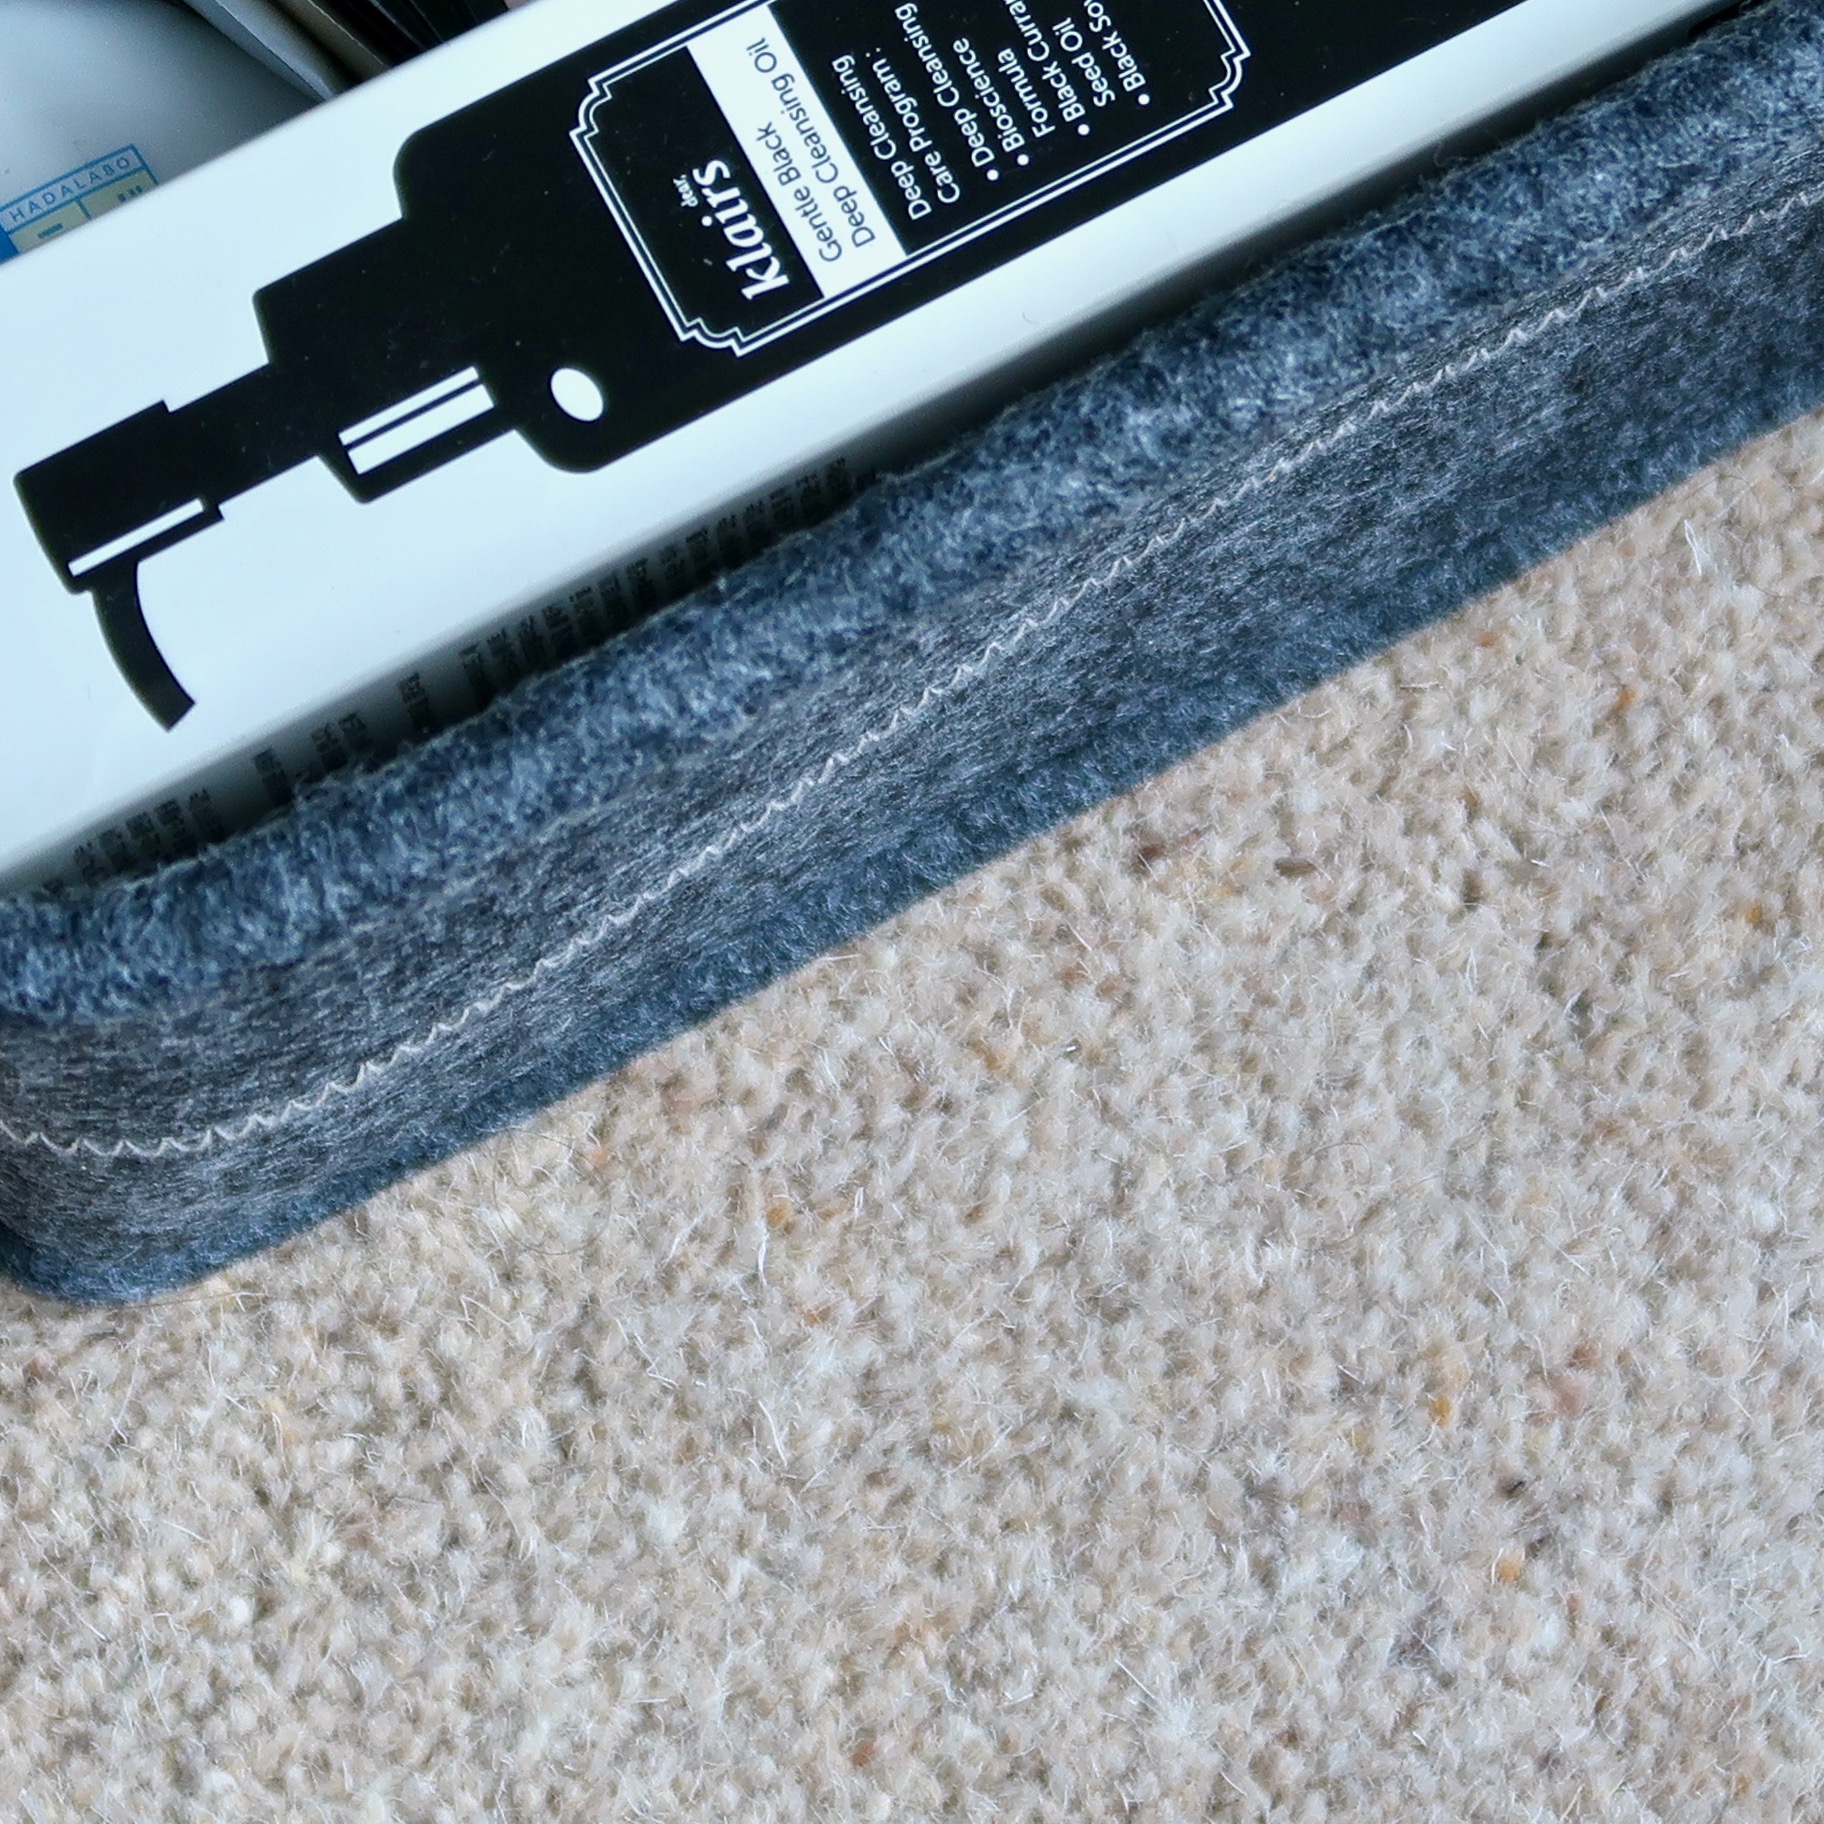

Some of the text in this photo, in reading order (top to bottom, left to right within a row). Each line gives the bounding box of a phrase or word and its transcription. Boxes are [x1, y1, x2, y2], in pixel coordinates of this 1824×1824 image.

[872, 58, 932, 151] Program
[894, 3, 994, 166] Deep Cleansing
[952, 37, 1024, 152] Bioscience
[997, 48, 1054, 137] Formula
[1041, 61, 1084, 121] Black
[1052, 17, 1115, 106] Seed Oil
[1101, 31, 1144, 91] Black
[746, 37, 875, 247] Deep Cleansing Oil
[831, 54, 931, 219] Deep Cleansing
[924, 151, 959, 203] Care
[8, 156, 129, 222] HADALABO
[673, 174, 698, 206] dear,
[692, 160, 787, 299] klairs
[756, 122, 842, 262] Gentle Black
